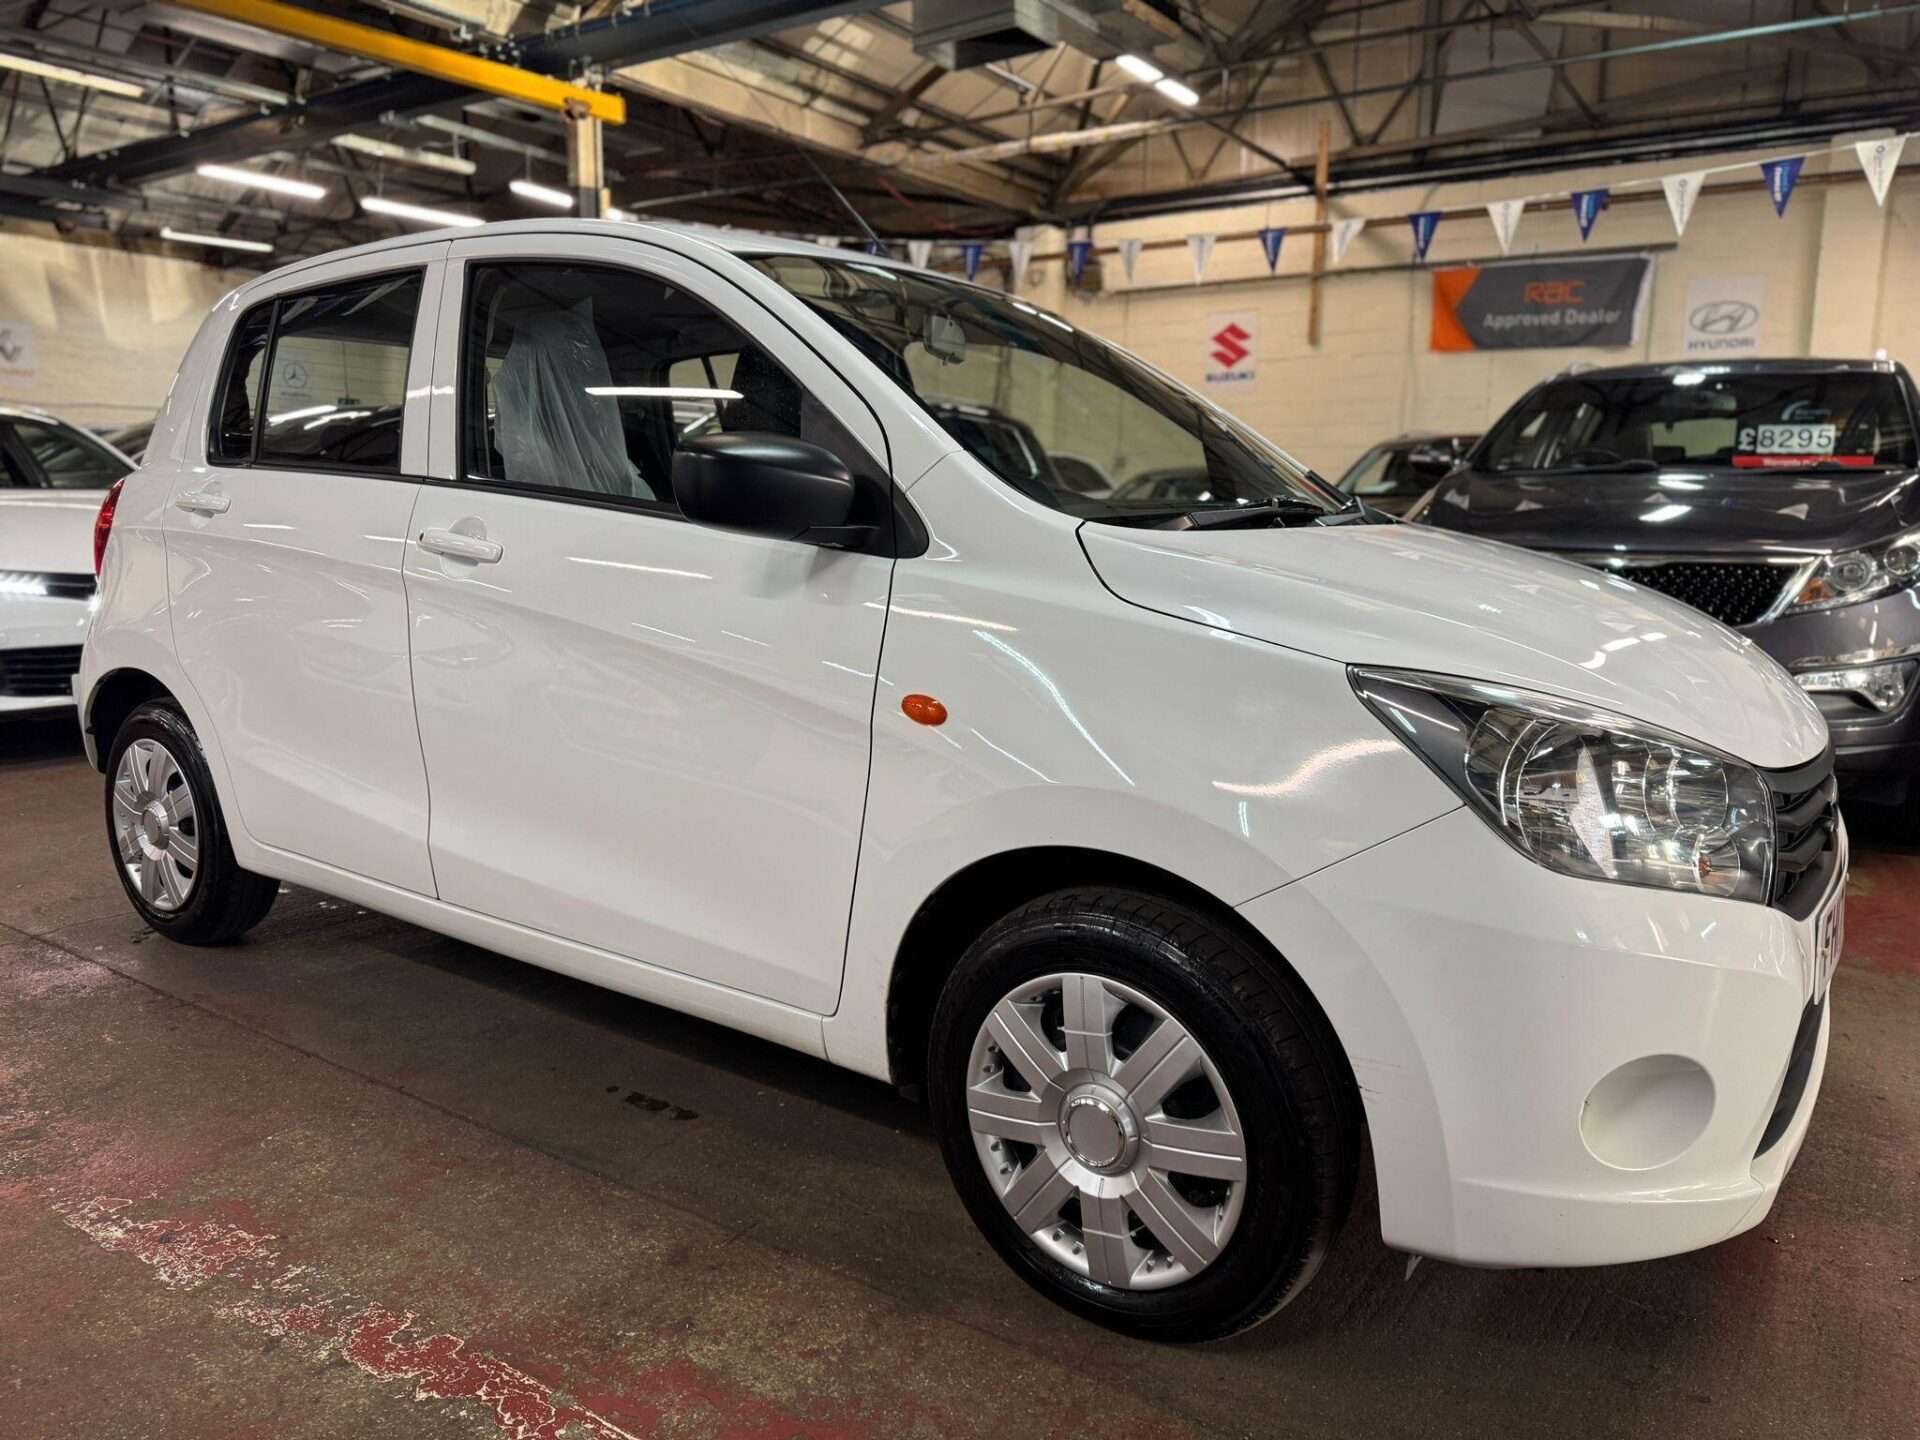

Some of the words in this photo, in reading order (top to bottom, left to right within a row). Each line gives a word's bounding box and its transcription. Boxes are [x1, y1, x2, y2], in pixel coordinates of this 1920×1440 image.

[1483, 311, 1561, 331] Approved
[1565, 308, 1621, 325] Dealer
[1738, 426, 1833, 450] £8295
